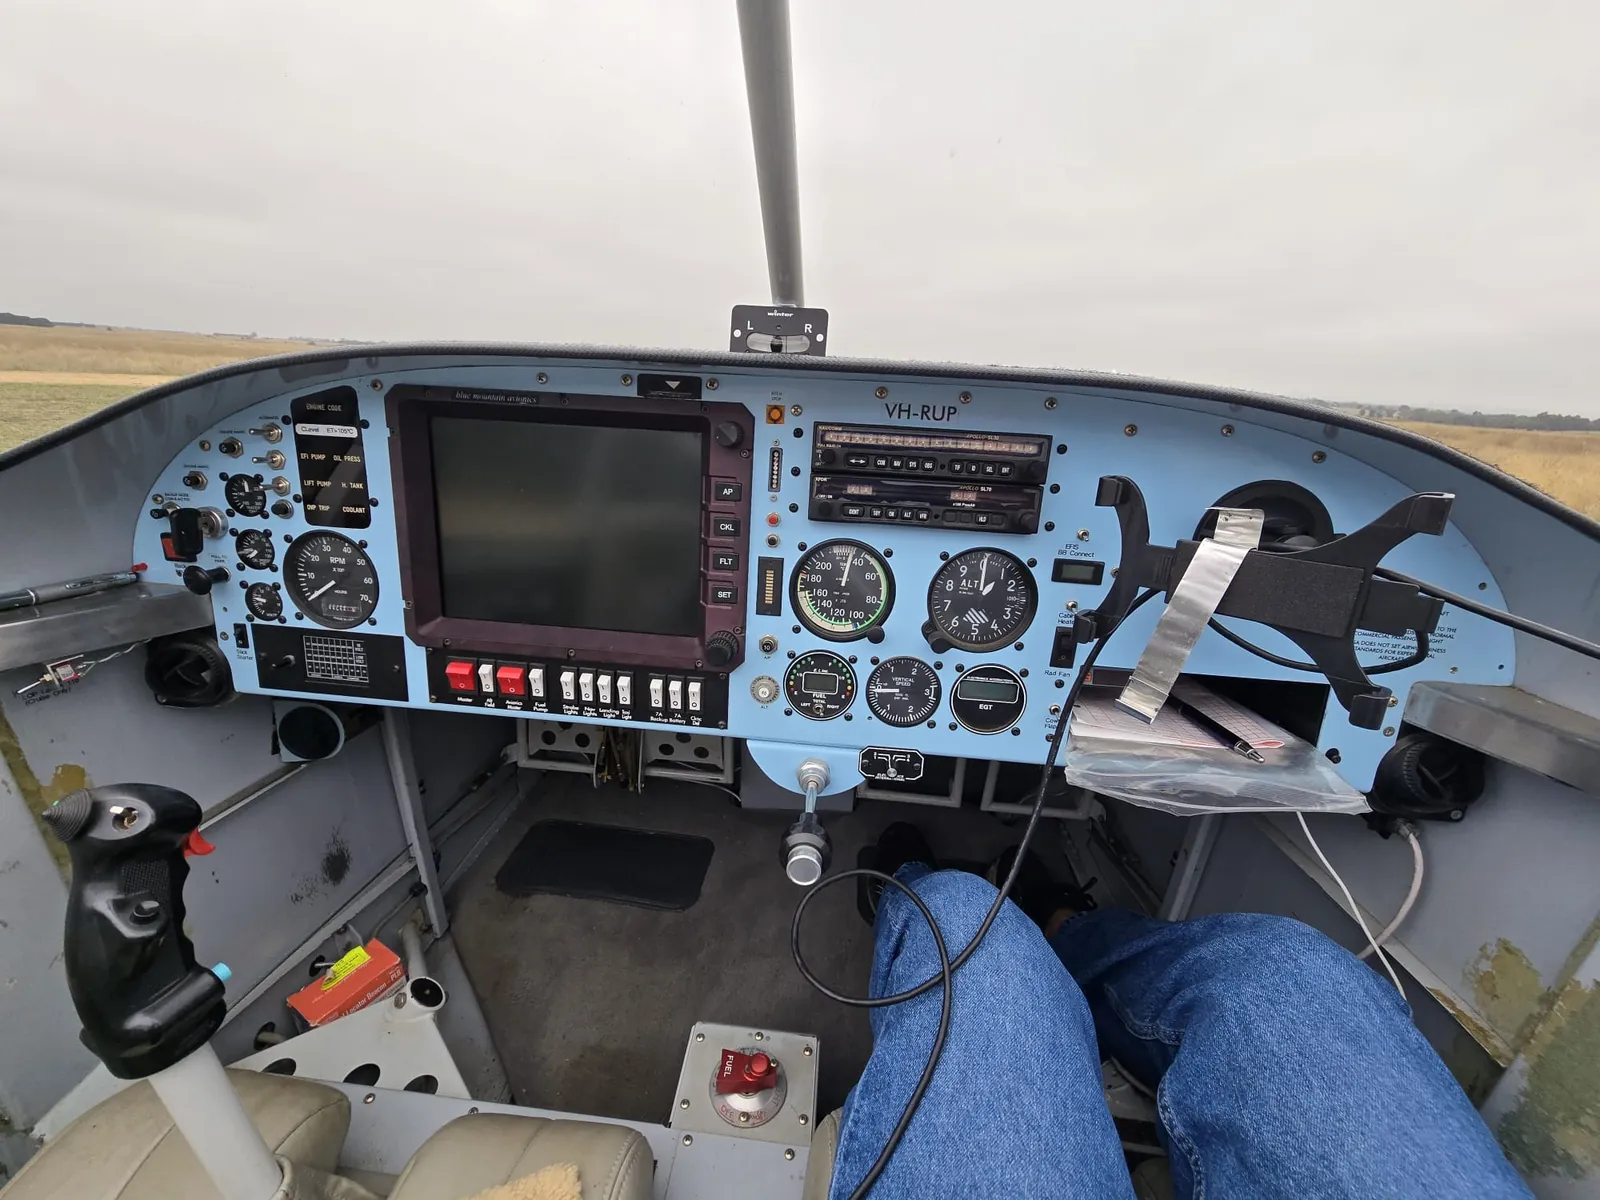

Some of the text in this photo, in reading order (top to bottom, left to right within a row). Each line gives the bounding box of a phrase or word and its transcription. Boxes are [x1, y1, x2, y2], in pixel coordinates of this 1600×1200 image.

[747, 320, 754, 330] L
[804, 323, 812, 333] R
[456, 390, 470, 399] blue
[885, 403, 957, 422] VH-RUP
[329, 556, 346, 564] RPM
[852, 558, 864, 566] 40
[816, 562, 832, 570] 200
[960, 565, 968, 577] 9
[806, 575, 821, 583] 180
[1000, 568, 1004, 580] 1
[946, 580, 954, 591] 8
[961, 579, 979, 588] ALT
[1007, 580, 1016, 592] 2
[813, 589, 828, 597] 160
[817, 599, 832, 607] 140
[866, 596, 877, 604] 80
[944, 600, 952, 611] 7
[830, 608, 845, 616] 120
[849, 610, 864, 619] 100
[1003, 608, 1011, 620] 3
[952, 616, 959, 627] 6
[991, 620, 998, 630] 4
[971, 624, 979, 635] 5
[367, 983, 387, 1000] Beacon
[390, 969, 401, 981] PLB
[724, 1055, 734, 1077] FUEL
